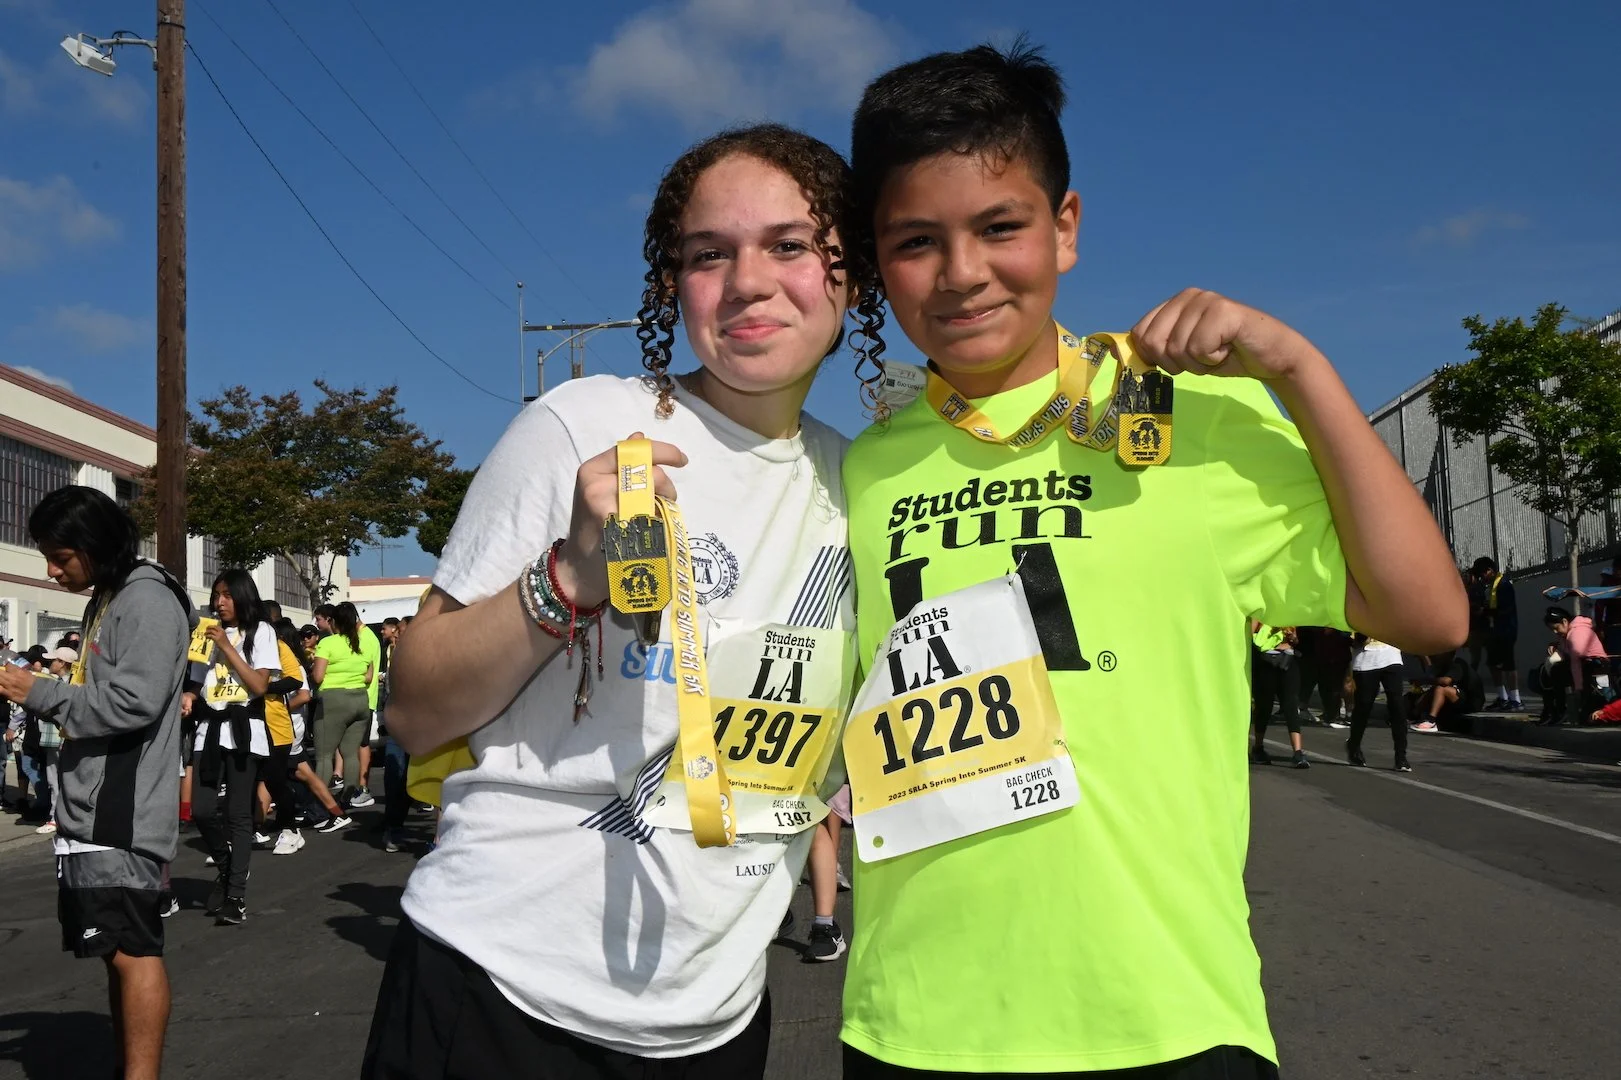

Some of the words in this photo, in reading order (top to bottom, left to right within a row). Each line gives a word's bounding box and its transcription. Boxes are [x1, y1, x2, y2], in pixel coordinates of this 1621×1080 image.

[1008, 420, 1046, 447] SPRIN
[888, 470, 1092, 530] Students
[884, 505, 1092, 565] run
[677, 567, 691, 607] INTO
[889, 620, 953, 651] run
[891, 606, 949, 637] Students
[677, 608, 701, 671] SUMMER
[761, 644, 813, 662] run
[765, 630, 816, 649] Students
[748, 657, 802, 704] LA
[886, 635, 963, 697] LA
[683, 673, 705, 696] 5K
[714, 706, 822, 768] 1397
[873, 675, 1020, 775] 1228
[728, 779, 748, 788] Spring
[888, 790, 907, 801] 2023
[908, 783, 928, 795] SRLA
[929, 774, 957, 788] Spring
[959, 770, 976, 780] Into
[978, 761, 1012, 775] Summer
[1014, 756, 1027, 765] 5K
[1006, 775, 1023, 788] BAG
[1025, 766, 1053, 782] CHECK
[772, 799, 784, 808] BAG
[785, 800, 807, 810] CHECK
[1011, 779, 1060, 810] 1228
[774, 811, 812, 827] 1397
